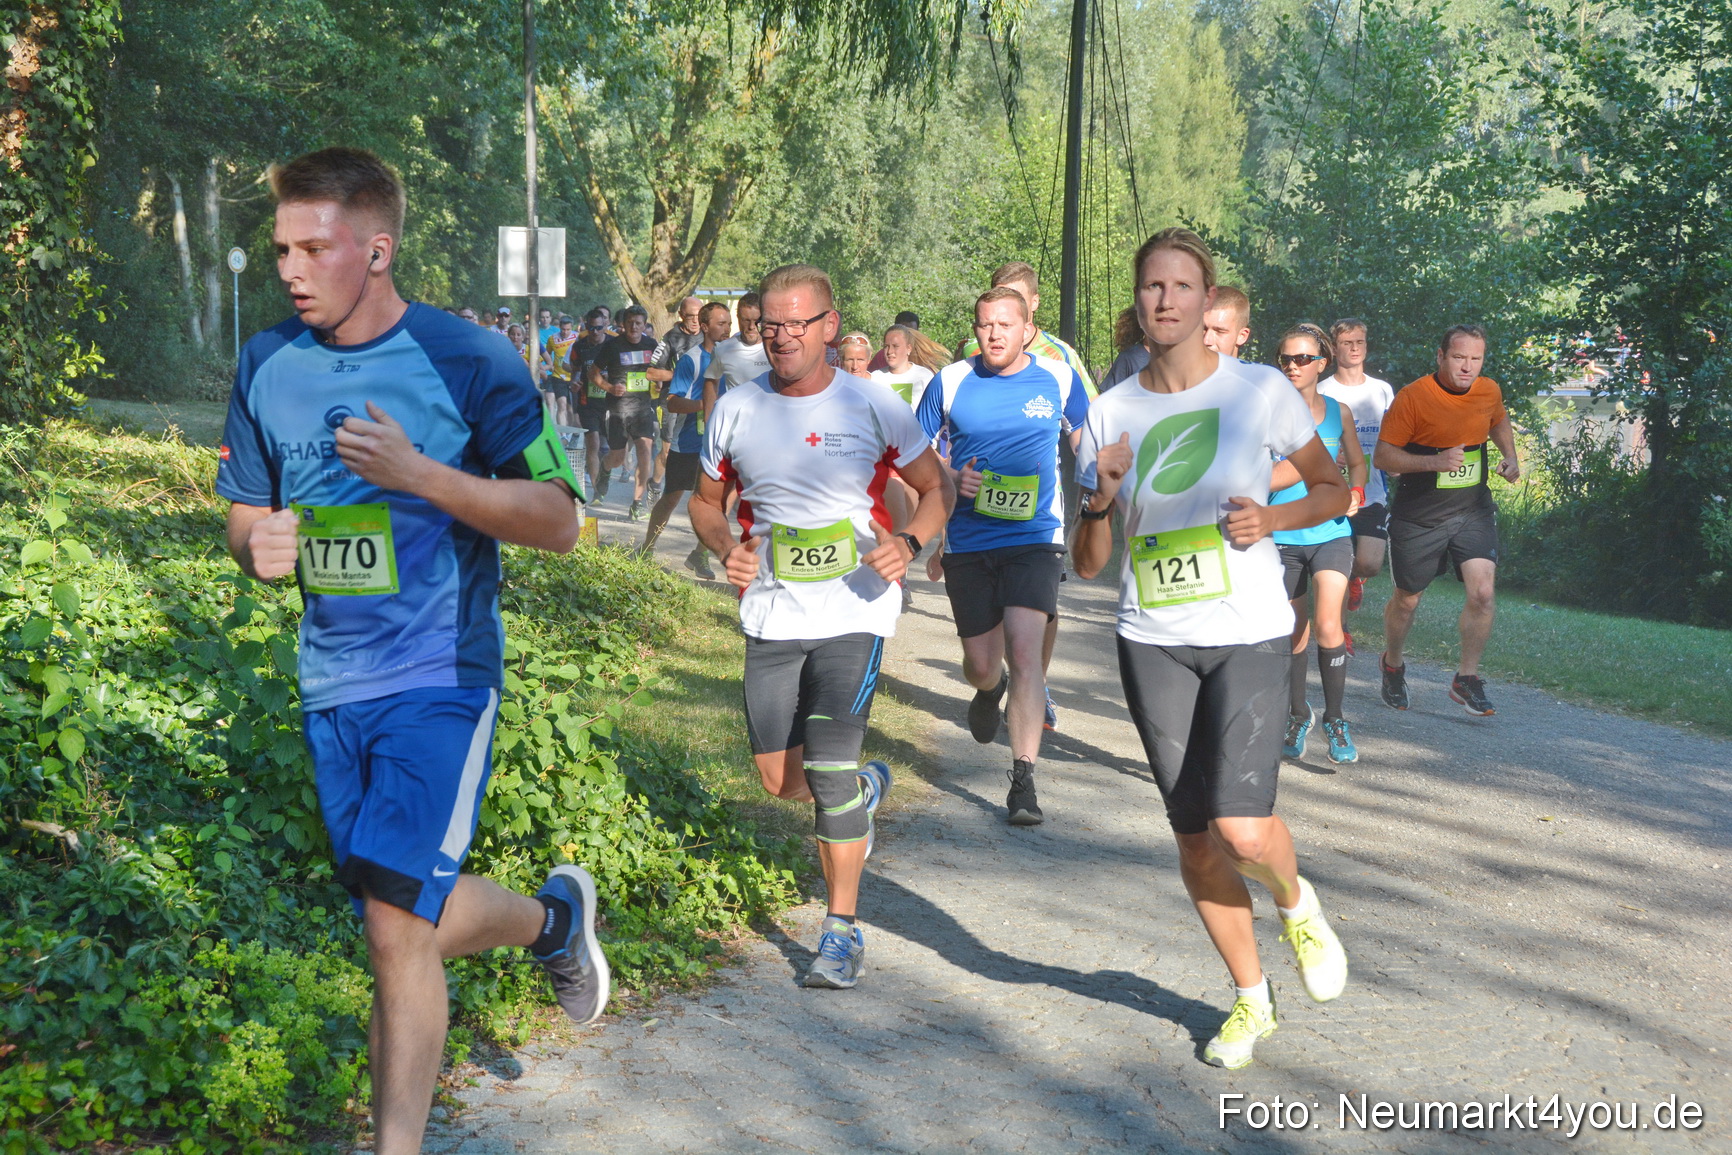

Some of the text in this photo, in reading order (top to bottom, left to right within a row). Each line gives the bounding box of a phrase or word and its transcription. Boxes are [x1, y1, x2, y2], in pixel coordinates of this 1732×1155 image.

[824, 449, 856, 457] Norbert
[985, 488, 1030, 508] 1972
[304, 537, 377, 570] 1770
[789, 544, 838, 566] 262
[816, 562, 840, 572] Norbert
[1152, 554, 1201, 585] 121
[1157, 582, 1205, 594] Haas Stefanie
